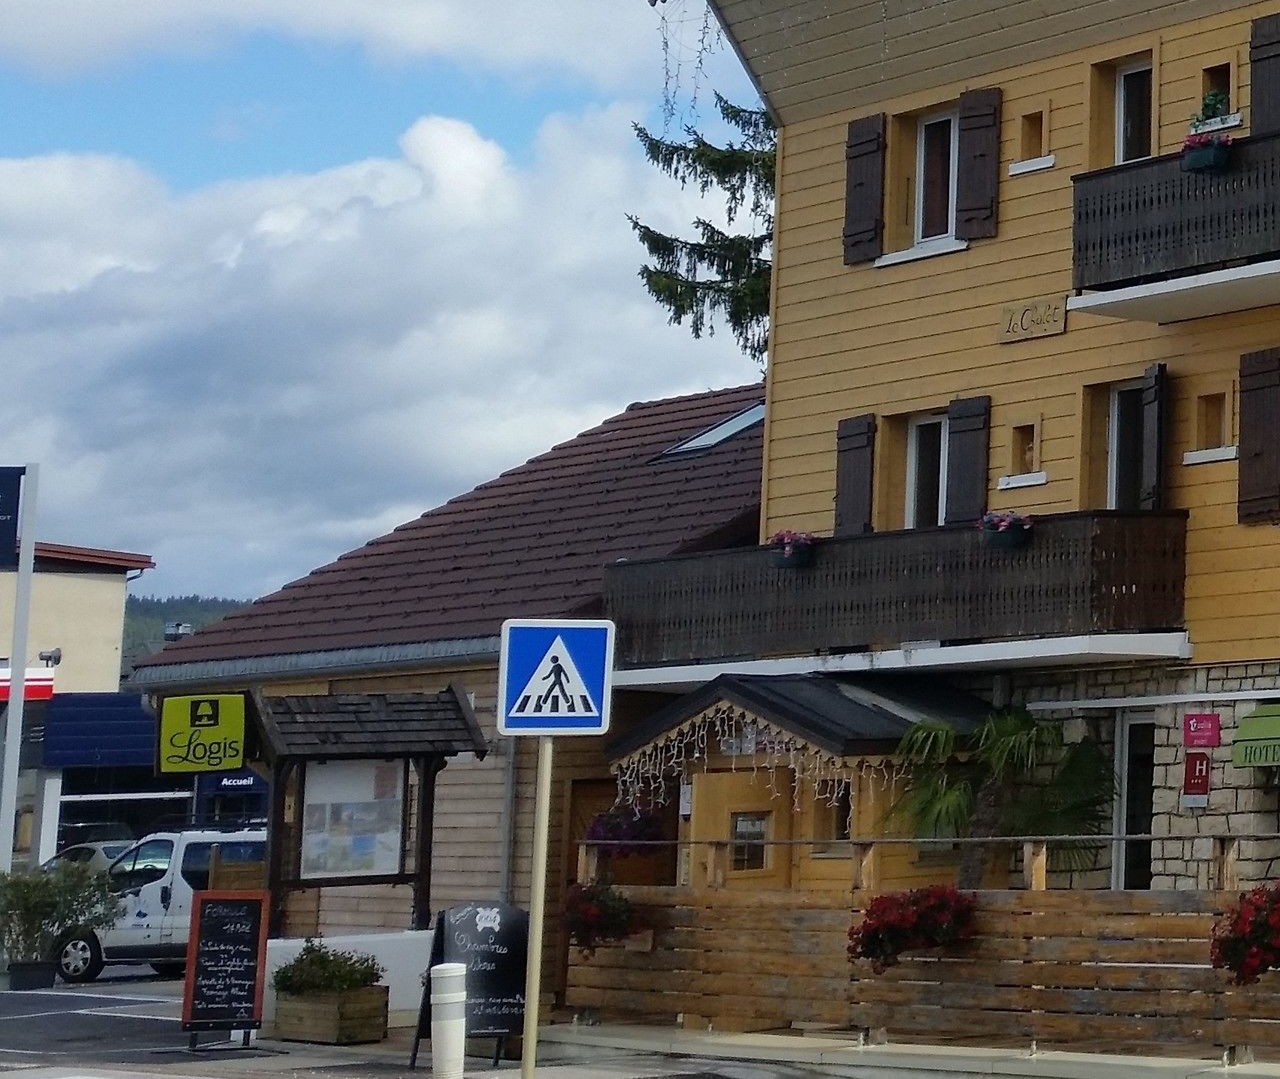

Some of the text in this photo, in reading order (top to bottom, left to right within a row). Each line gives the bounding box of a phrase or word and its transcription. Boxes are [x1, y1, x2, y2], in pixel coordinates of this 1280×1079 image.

[166, 729, 240, 767] Logis
[1195, 760, 1207, 776] H
[221, 777, 254, 786] Accueil
